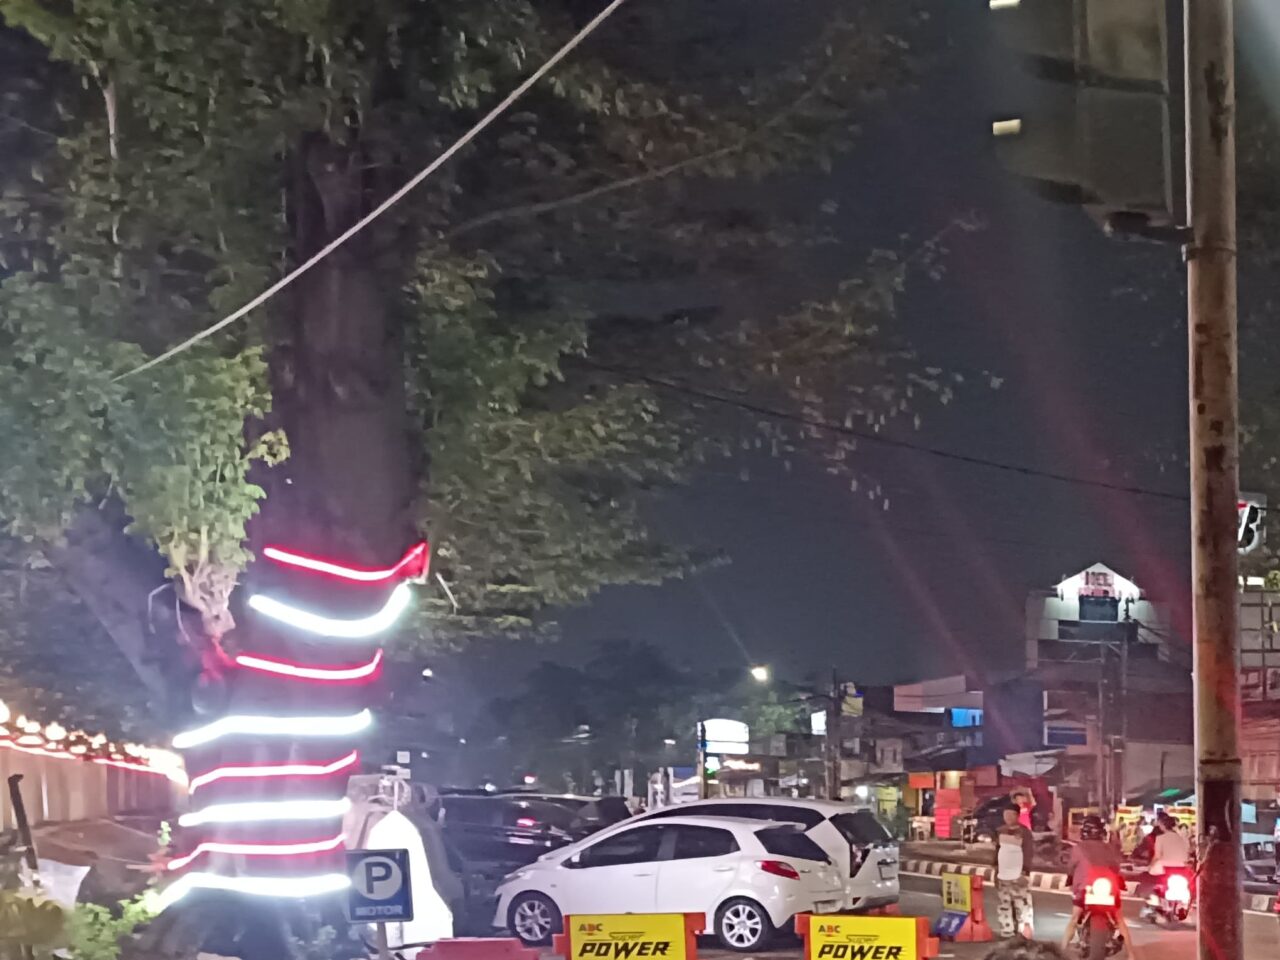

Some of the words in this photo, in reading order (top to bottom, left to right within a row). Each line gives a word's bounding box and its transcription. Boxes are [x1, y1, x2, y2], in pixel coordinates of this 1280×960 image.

[364, 861, 392, 894] P
[355, 905, 403, 916] MOTOR
[579, 923, 603, 932] ABC
[818, 925, 841, 933] ABC
[578, 941, 671, 960] POWER
